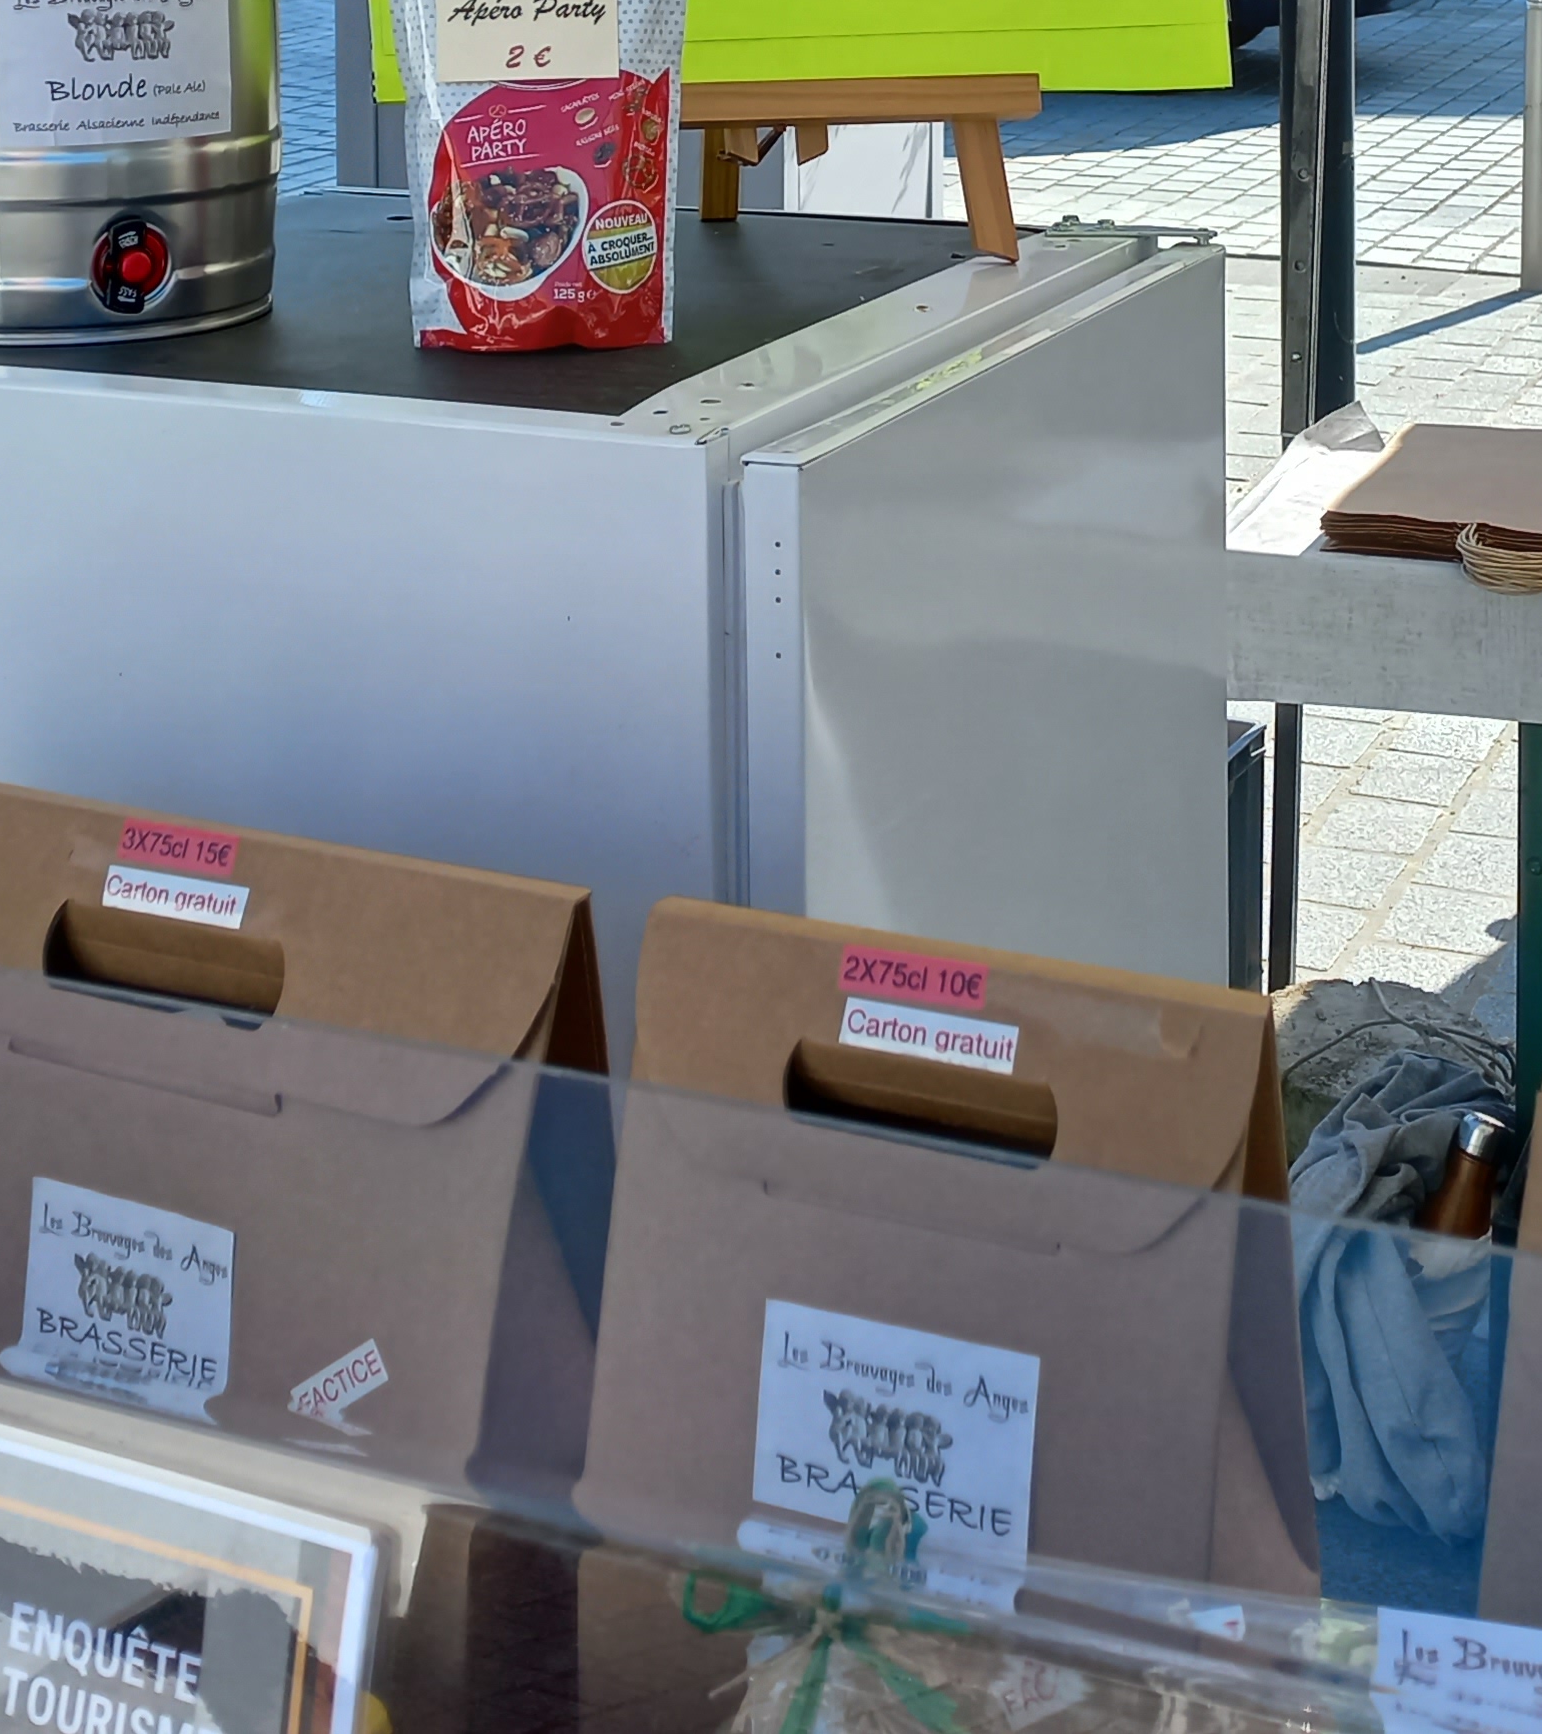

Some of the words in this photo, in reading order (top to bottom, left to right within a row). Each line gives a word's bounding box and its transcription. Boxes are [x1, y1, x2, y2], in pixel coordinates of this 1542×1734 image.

[505, 45, 527, 69] 2
[533, 45, 552, 69] €
[45, 73, 148, 102] Blonde
[13, 119, 70, 132] Brasserie
[76, 117, 146, 131] Alsacienne
[466, 117, 528, 145] APÉRO
[470, 137, 528, 161] PARTY
[595, 212, 649, 230] NOUVEAU
[590, 241, 655, 266] ABSOLUMENT
[553, 288, 576, 300] 125
[122, 827, 189, 861] 3X75cl
[194, 837, 233, 868] 15€
[105, 872, 170, 907] Carton
[175, 888, 238, 919] gratuit
[843, 954, 929, 994] 2X75cl
[937, 966, 983, 1001] 10€
[846, 1007, 927, 1048] Carton
[935, 1026, 1015, 1063] gratuit
[36, 1307, 217, 1381] BRASSERIE
[297, 1349, 381, 1411] FACTICE
[962, 1375, 1029, 1424] Anges
[775, 1453, 1012, 1537] BRASERIE
[9, 1601, 202, 1705] ENQUÊTE
